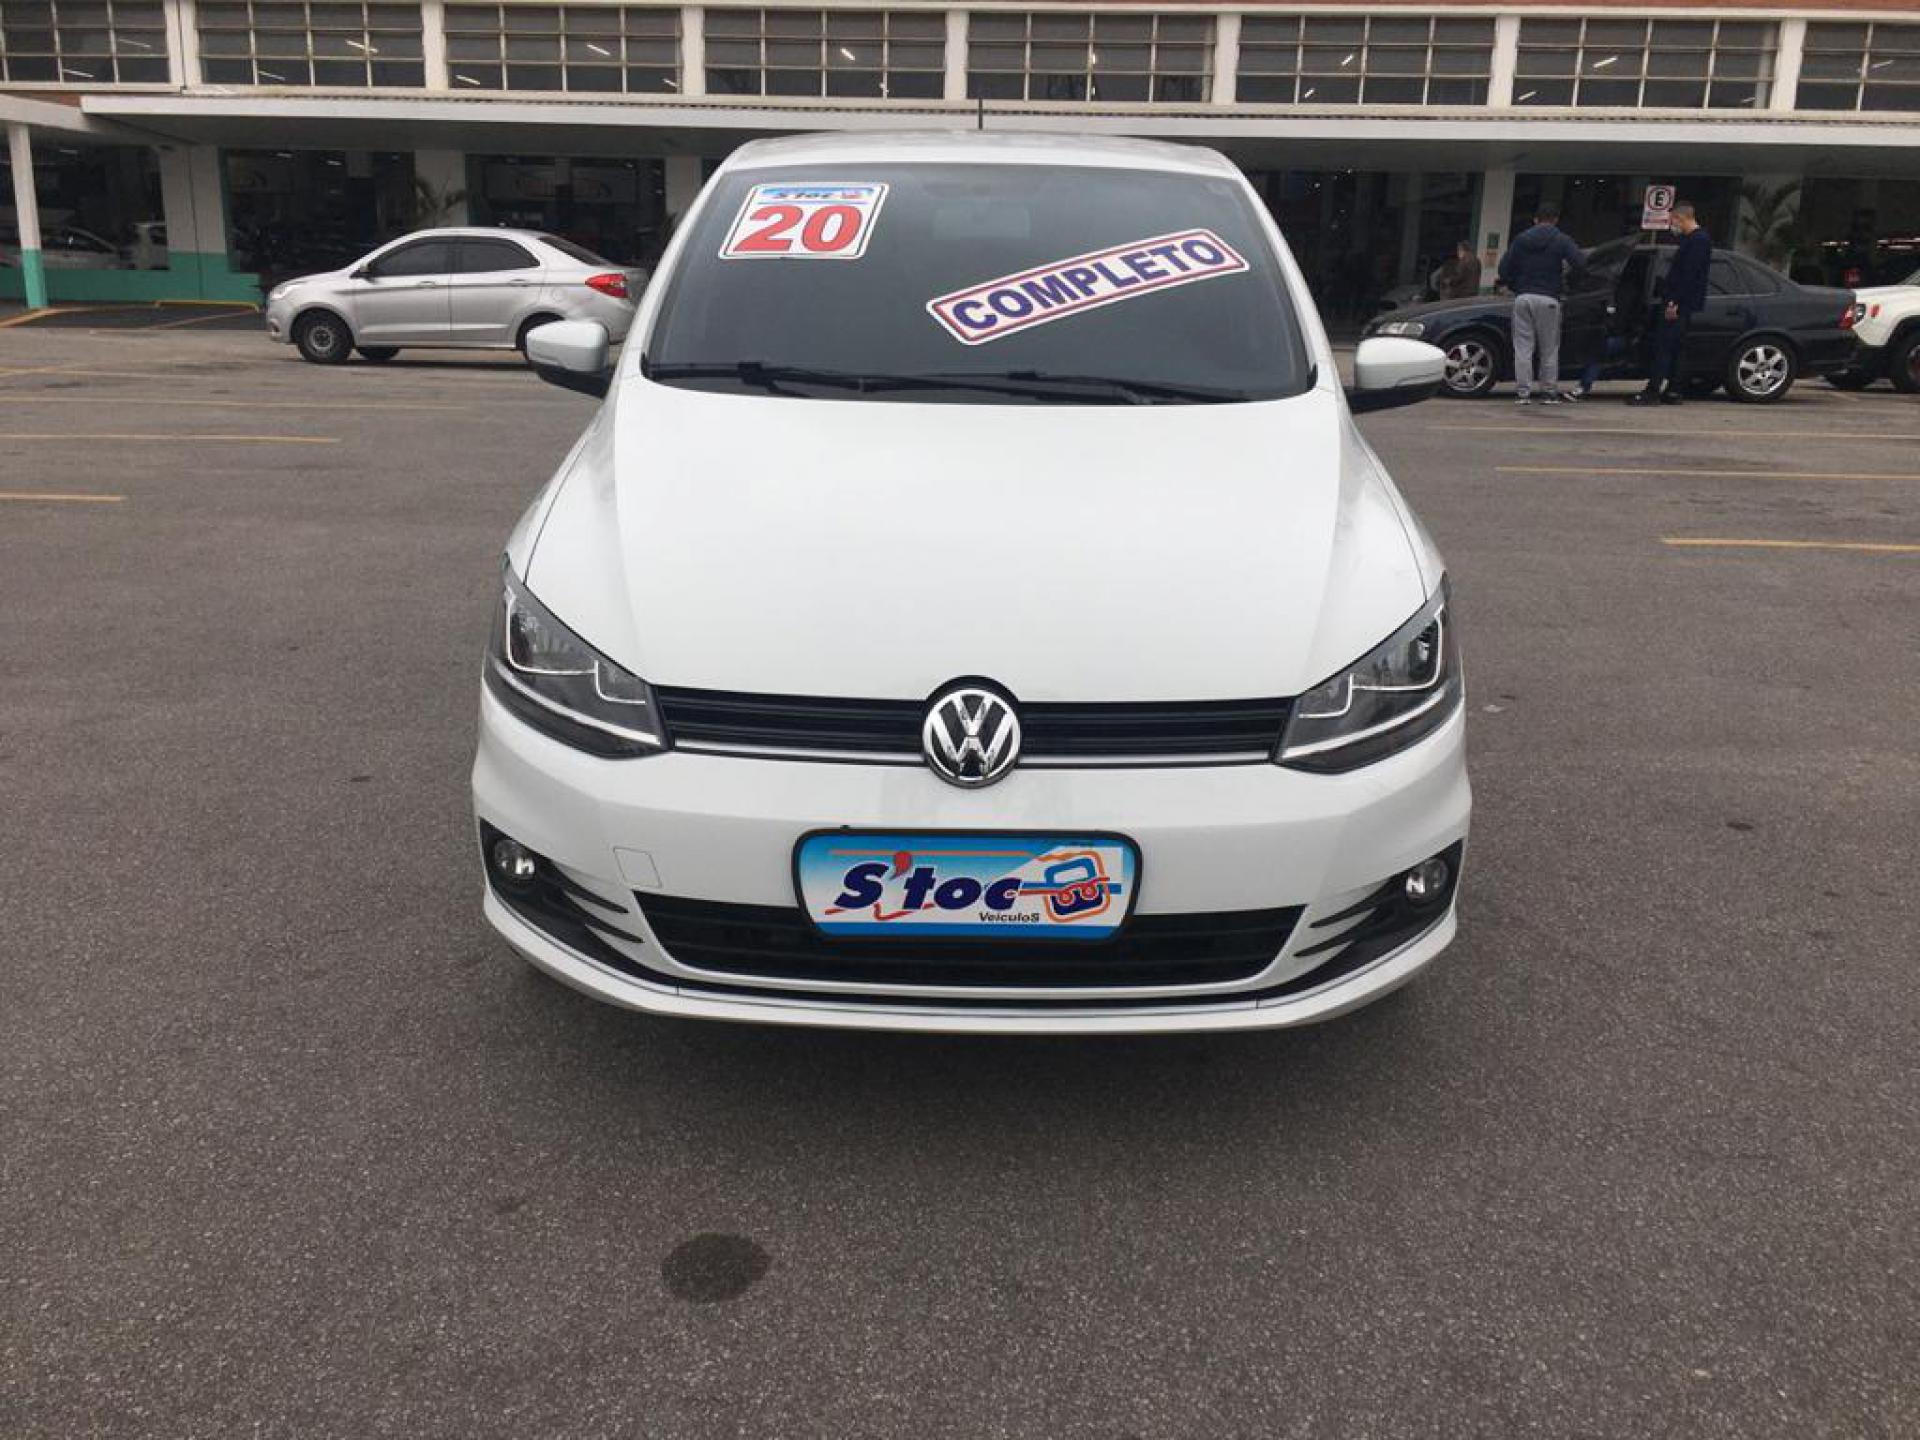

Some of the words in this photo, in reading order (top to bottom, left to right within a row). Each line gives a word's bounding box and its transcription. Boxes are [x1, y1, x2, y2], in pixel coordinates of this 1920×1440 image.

[1655, 190, 1665, 207] E
[734, 205, 863, 252] 20
[952, 239, 1225, 329] COMPLETO
